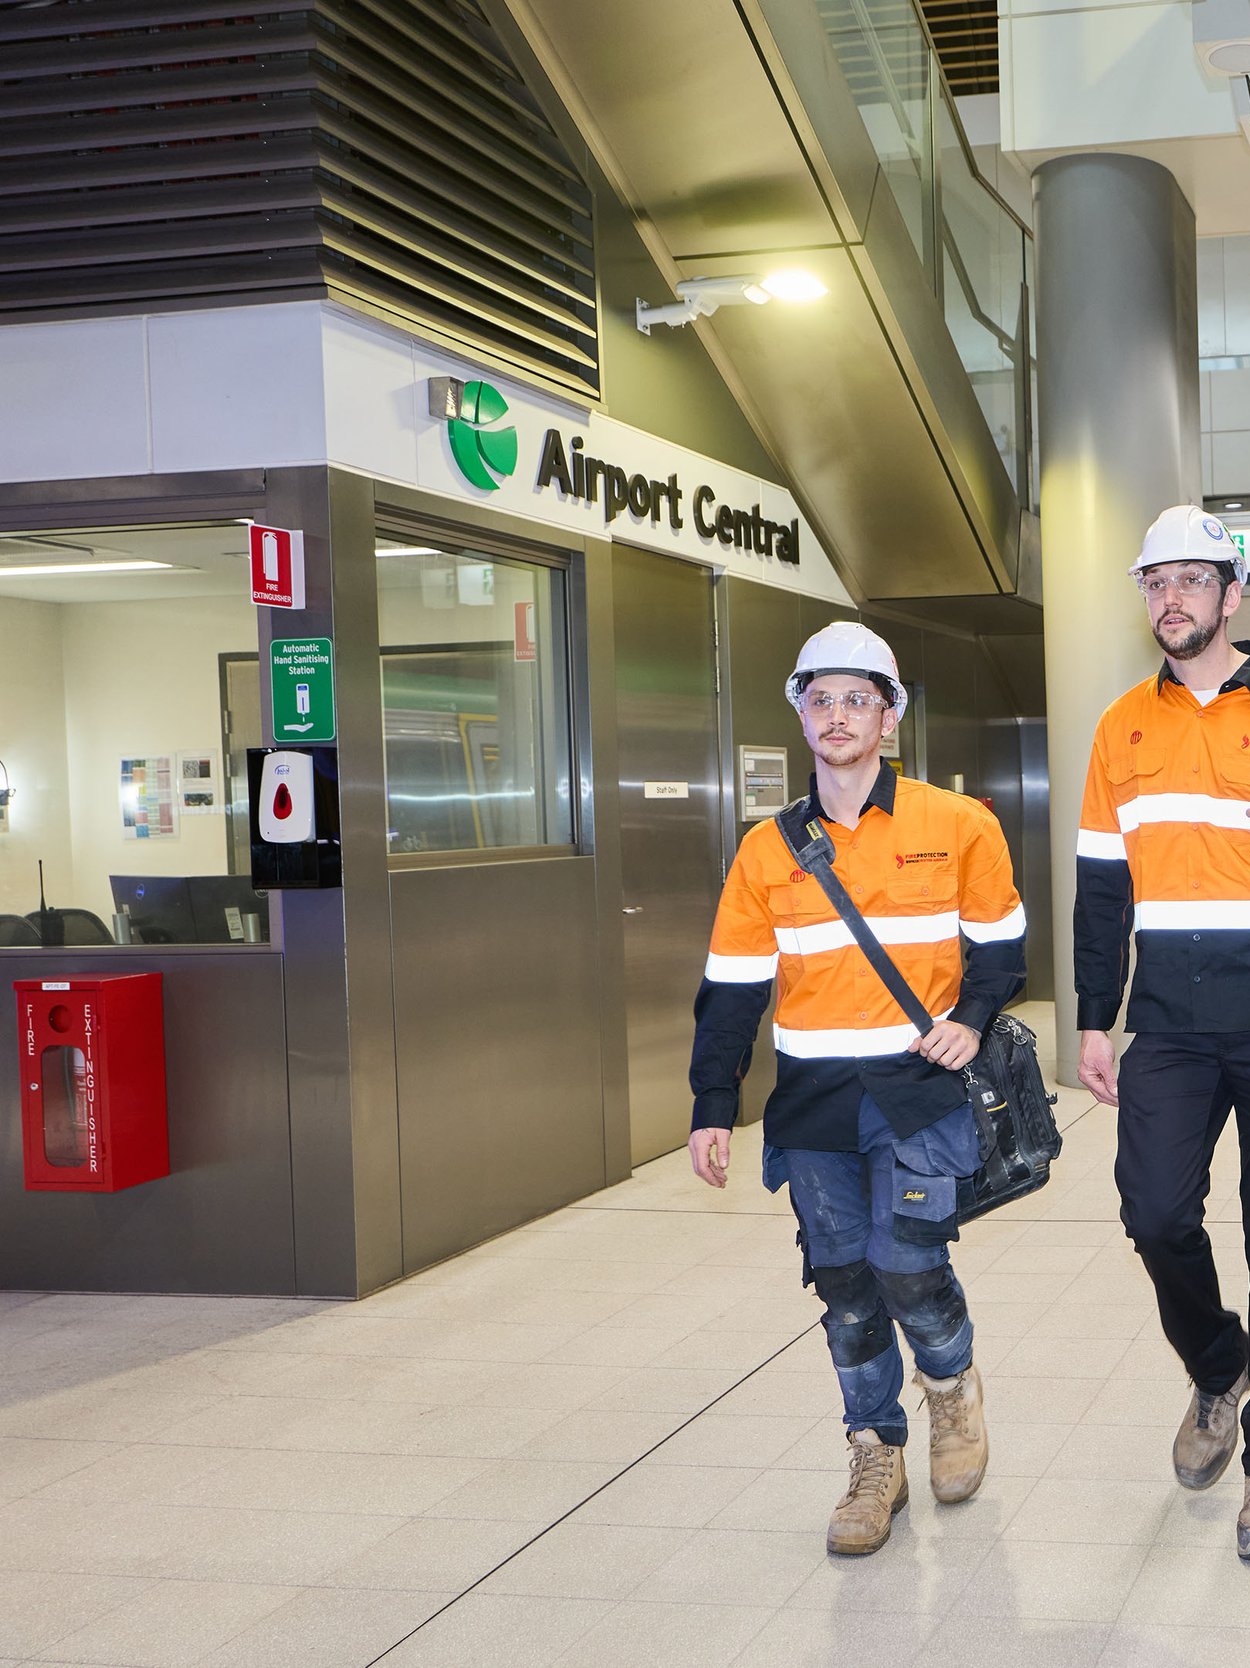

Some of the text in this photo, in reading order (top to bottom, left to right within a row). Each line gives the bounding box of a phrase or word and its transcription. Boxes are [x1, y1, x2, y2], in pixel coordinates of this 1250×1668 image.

[536, 428, 800, 565] Airport Central
[266, 583, 279, 591] FIRE
[253, 591, 292, 603] EXTINGUISHER
[282, 643, 320, 653] Automatic
[273, 654, 329, 665] Hand Sanitising
[288, 665, 315, 675] Station
[656, 786, 678, 794] Staff Only
[27, 1004, 35, 1056] FIRE
[84, 1004, 97, 1172] EXTINGUISHER
